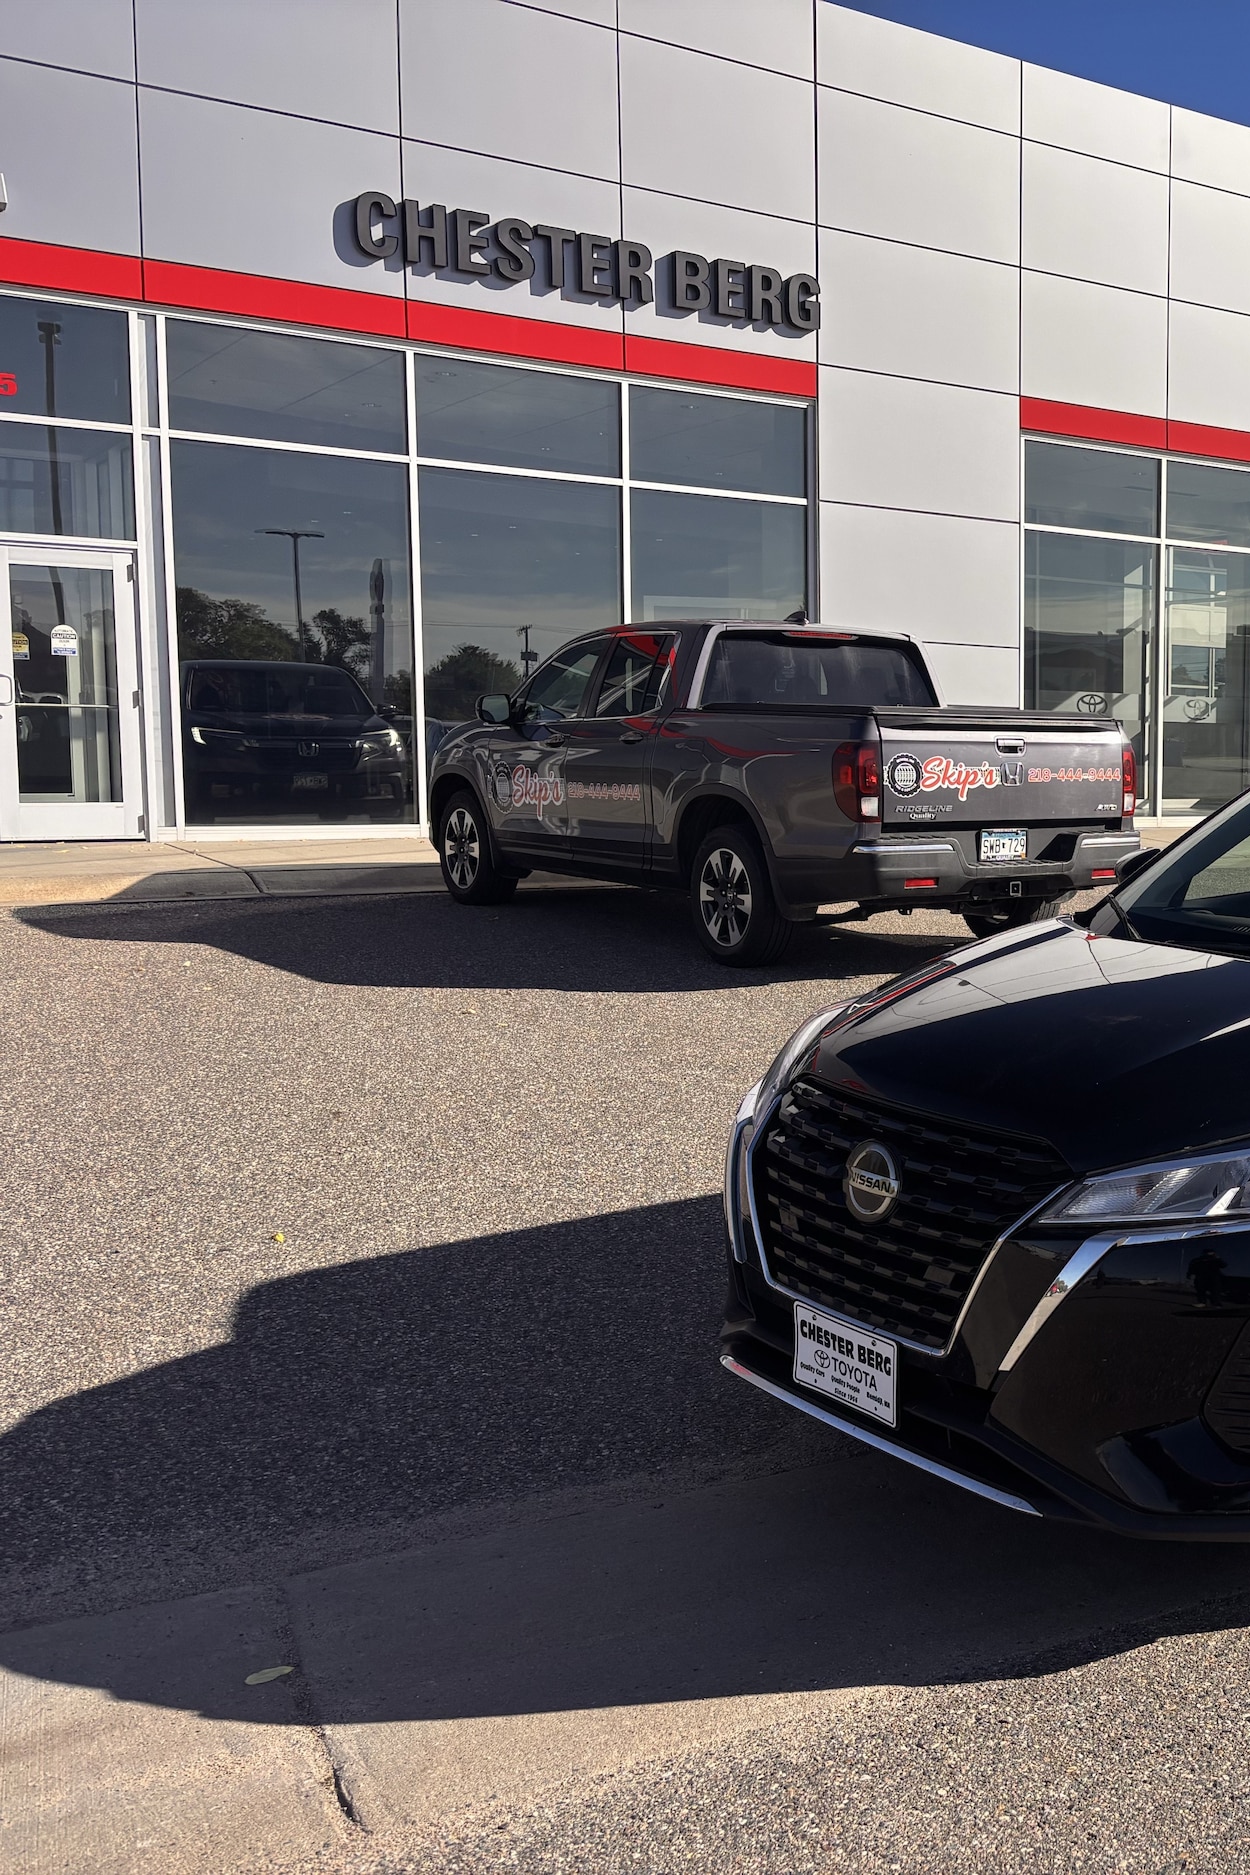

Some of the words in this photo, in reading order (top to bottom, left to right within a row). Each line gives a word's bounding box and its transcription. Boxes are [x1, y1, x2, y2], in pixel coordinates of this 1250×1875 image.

[353, 191, 653, 303] CHESTER
[671, 250, 821, 331] BERG
[512, 764, 563, 820] Skip's
[567, 782, 641, 801] 218-444-9444
[920, 756, 998, 801] Skip's
[1028, 767, 1121, 783] 218-444-9444
[896, 805, 953, 813] RIDGELINE
[909, 812, 936, 820] Quality
[983, 839, 1000, 854] SWB
[1008, 838, 1025, 853] 729
[851, 1171, 892, 1193] NISSAN
[800, 1319, 855, 1360] CHESTER
[857, 1344, 892, 1377] BERG
[831, 1356, 878, 1392] TOYOTA
